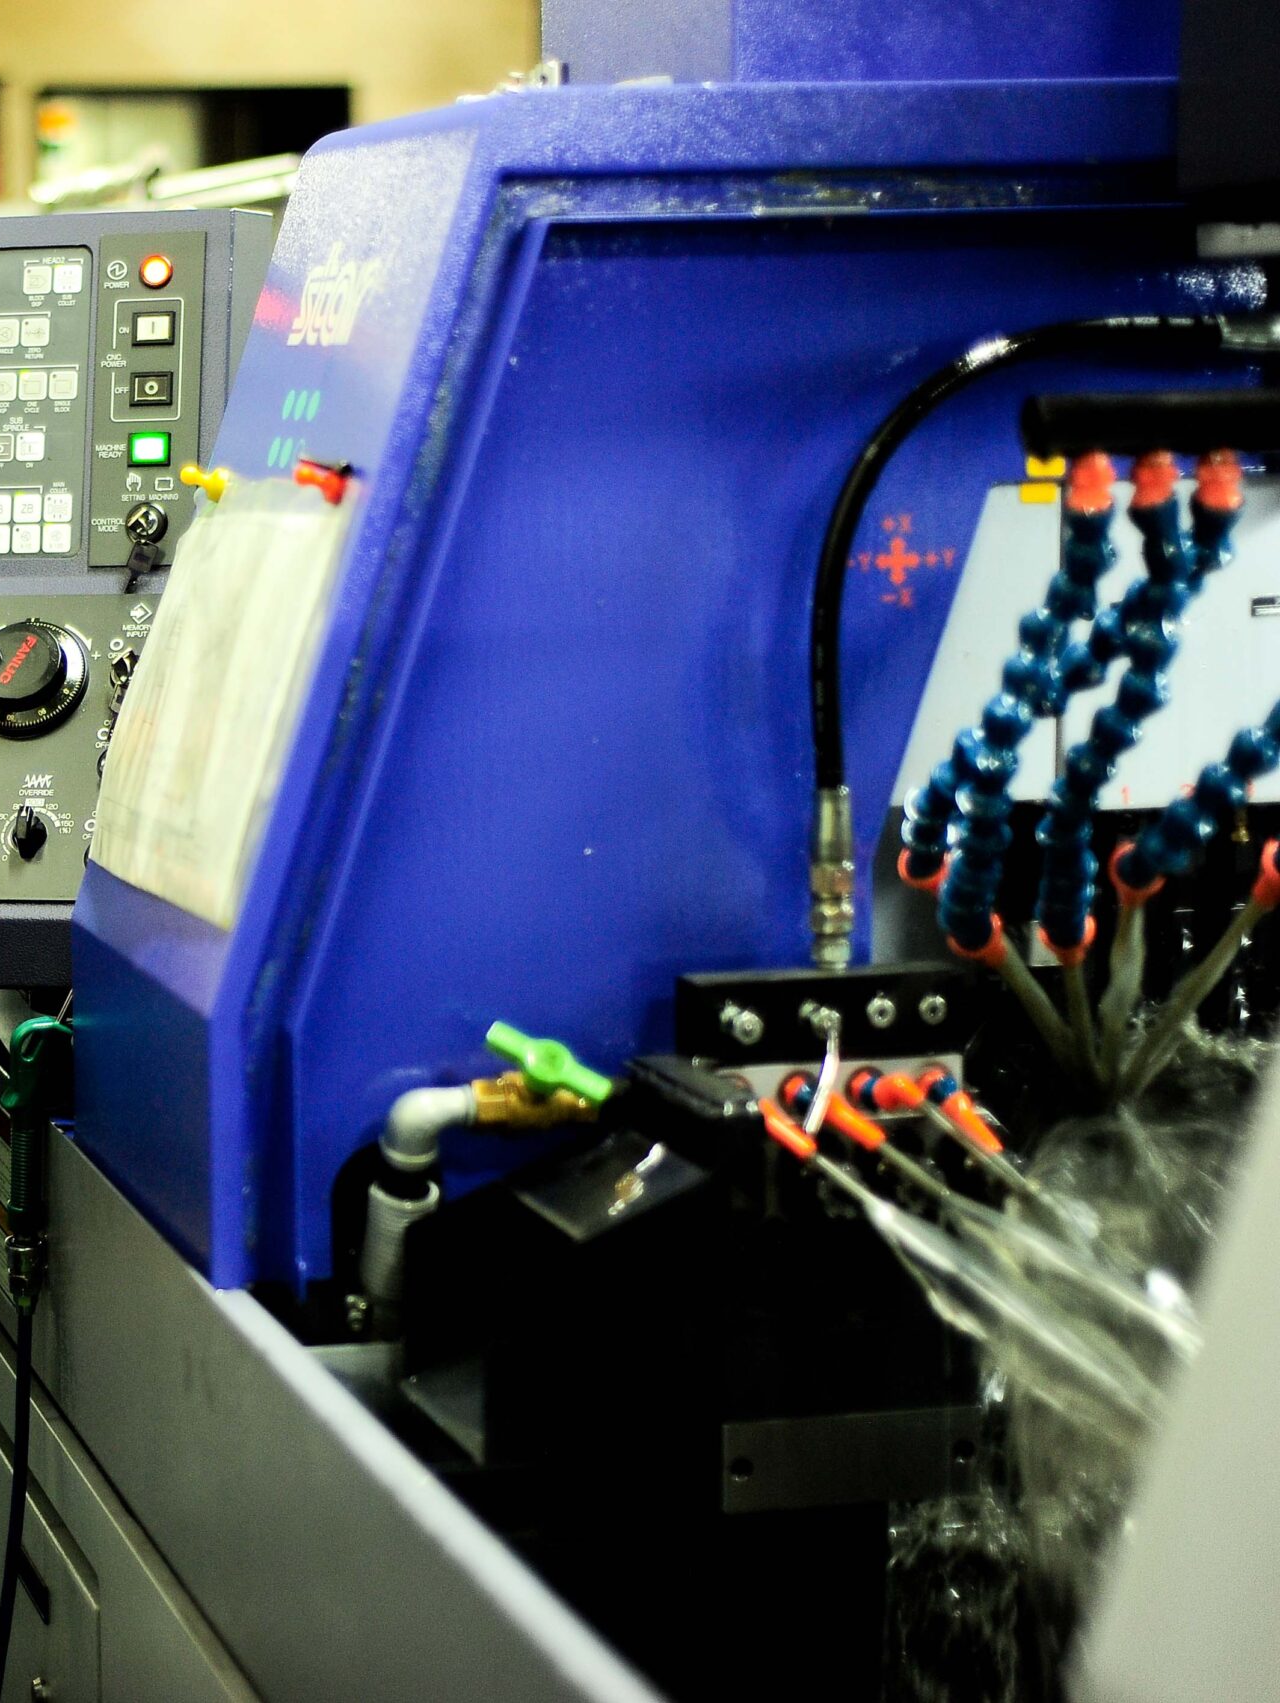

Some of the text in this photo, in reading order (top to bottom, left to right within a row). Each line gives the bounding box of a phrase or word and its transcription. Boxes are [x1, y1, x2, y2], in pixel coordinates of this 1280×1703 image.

[103, 281, 130, 289] POWER
[100, 360, 127, 368] POWER
[2, 424, 30, 432] SPINDLE
[95, 444, 127, 452] MACHINE
[20, 504, 33, 513] ZB
[91, 518, 125, 526] CONTROL
